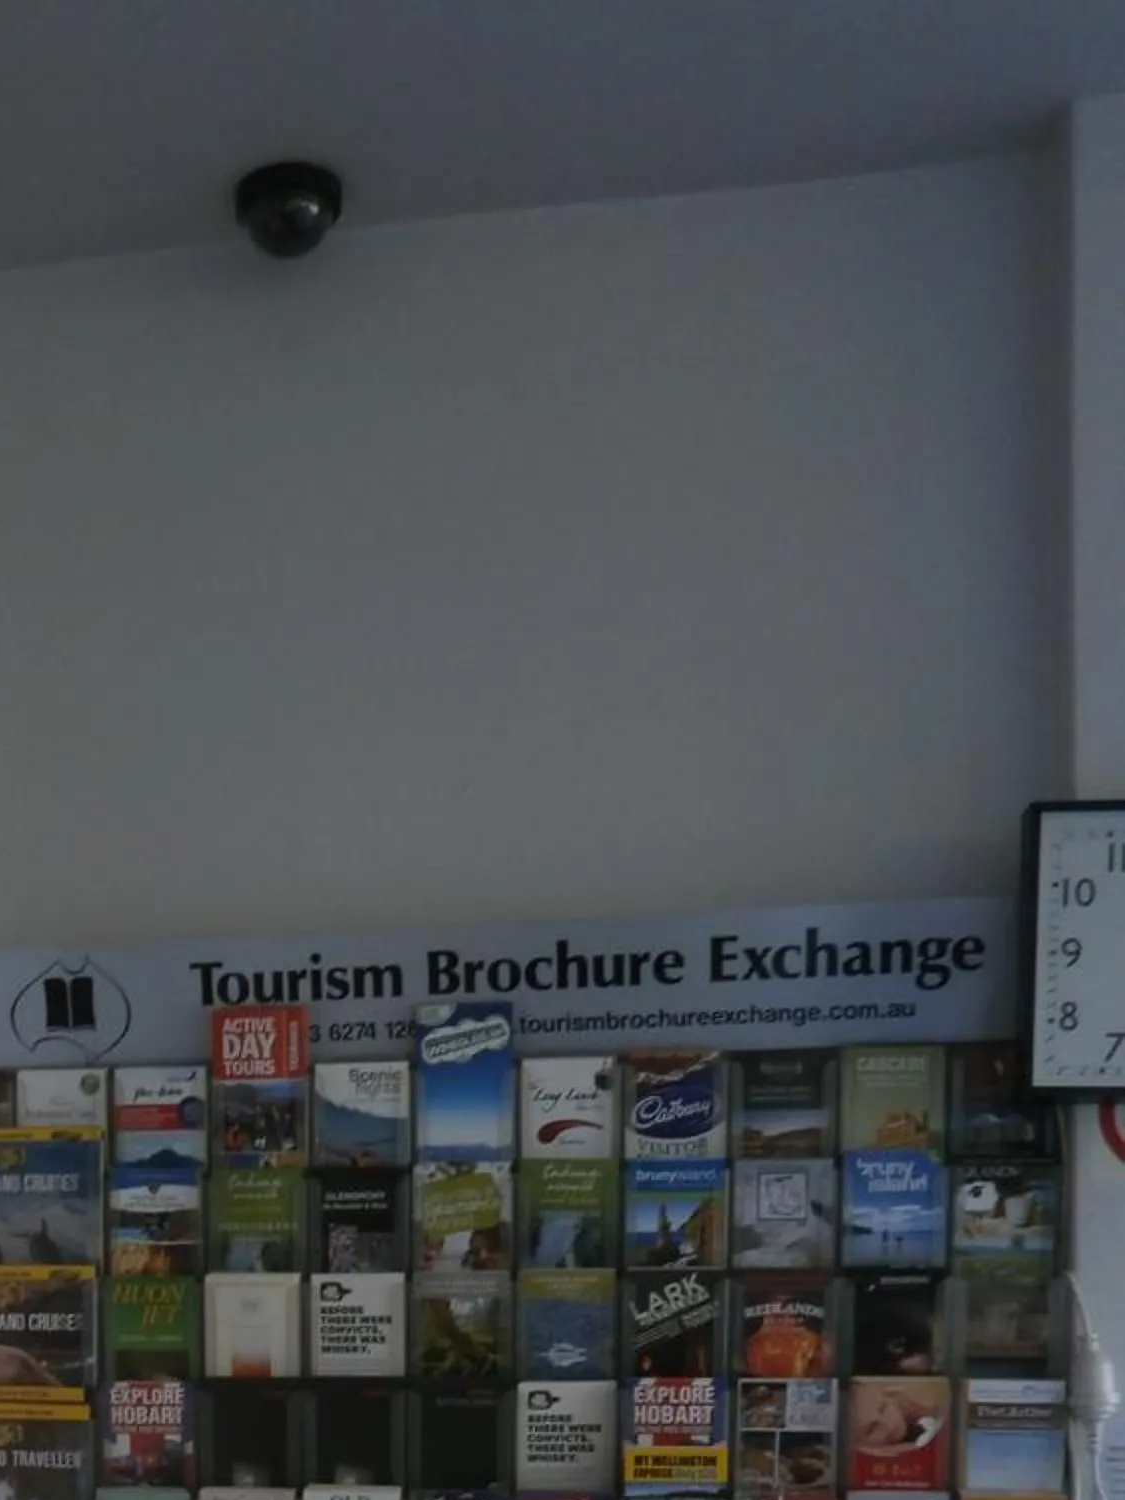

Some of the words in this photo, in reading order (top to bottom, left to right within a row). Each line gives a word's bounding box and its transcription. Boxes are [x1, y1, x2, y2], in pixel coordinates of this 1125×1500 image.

[1061, 877, 1096, 908] 10
[1061, 938, 1083, 968] 9
[190, 953, 402, 1006] Tourism
[427, 939, 685, 995] Brochure
[710, 927, 986, 990] Exchange
[223, 1017, 276, 1033] ACTIVE
[1058, 1001, 1078, 1032] 8
[329, 1020, 377, 1042] 6274
[223, 1032, 277, 1060] DAY
[1104, 1033, 1125, 1063] 7
[224, 1059, 276, 1077] TOURS
[348, 1068, 401, 1083] Scenic
[630, 1095, 710, 1128] Cadbury
[629, 1271, 710, 1321] LARK
[320, 1315, 356, 1324] THERE
[359, 1315, 392, 1324] WERE
[320, 1335, 357, 1344] THERE
[360, 1335, 385, 1344] WAS
[109, 1387, 186, 1406] EXPLORE
[634, 1385, 716, 1404] EXPLORE
[110, 1405, 186, 1426] HOBART
[634, 1404, 716, 1426] HOBART
[528, 1423, 565, 1433] THERE
[567, 1423, 602, 1433] WERE
[528, 1443, 565, 1453] THERE
[567, 1443, 595, 1453] WAS
[12, 1449, 84, 1470] TRAVELLER
